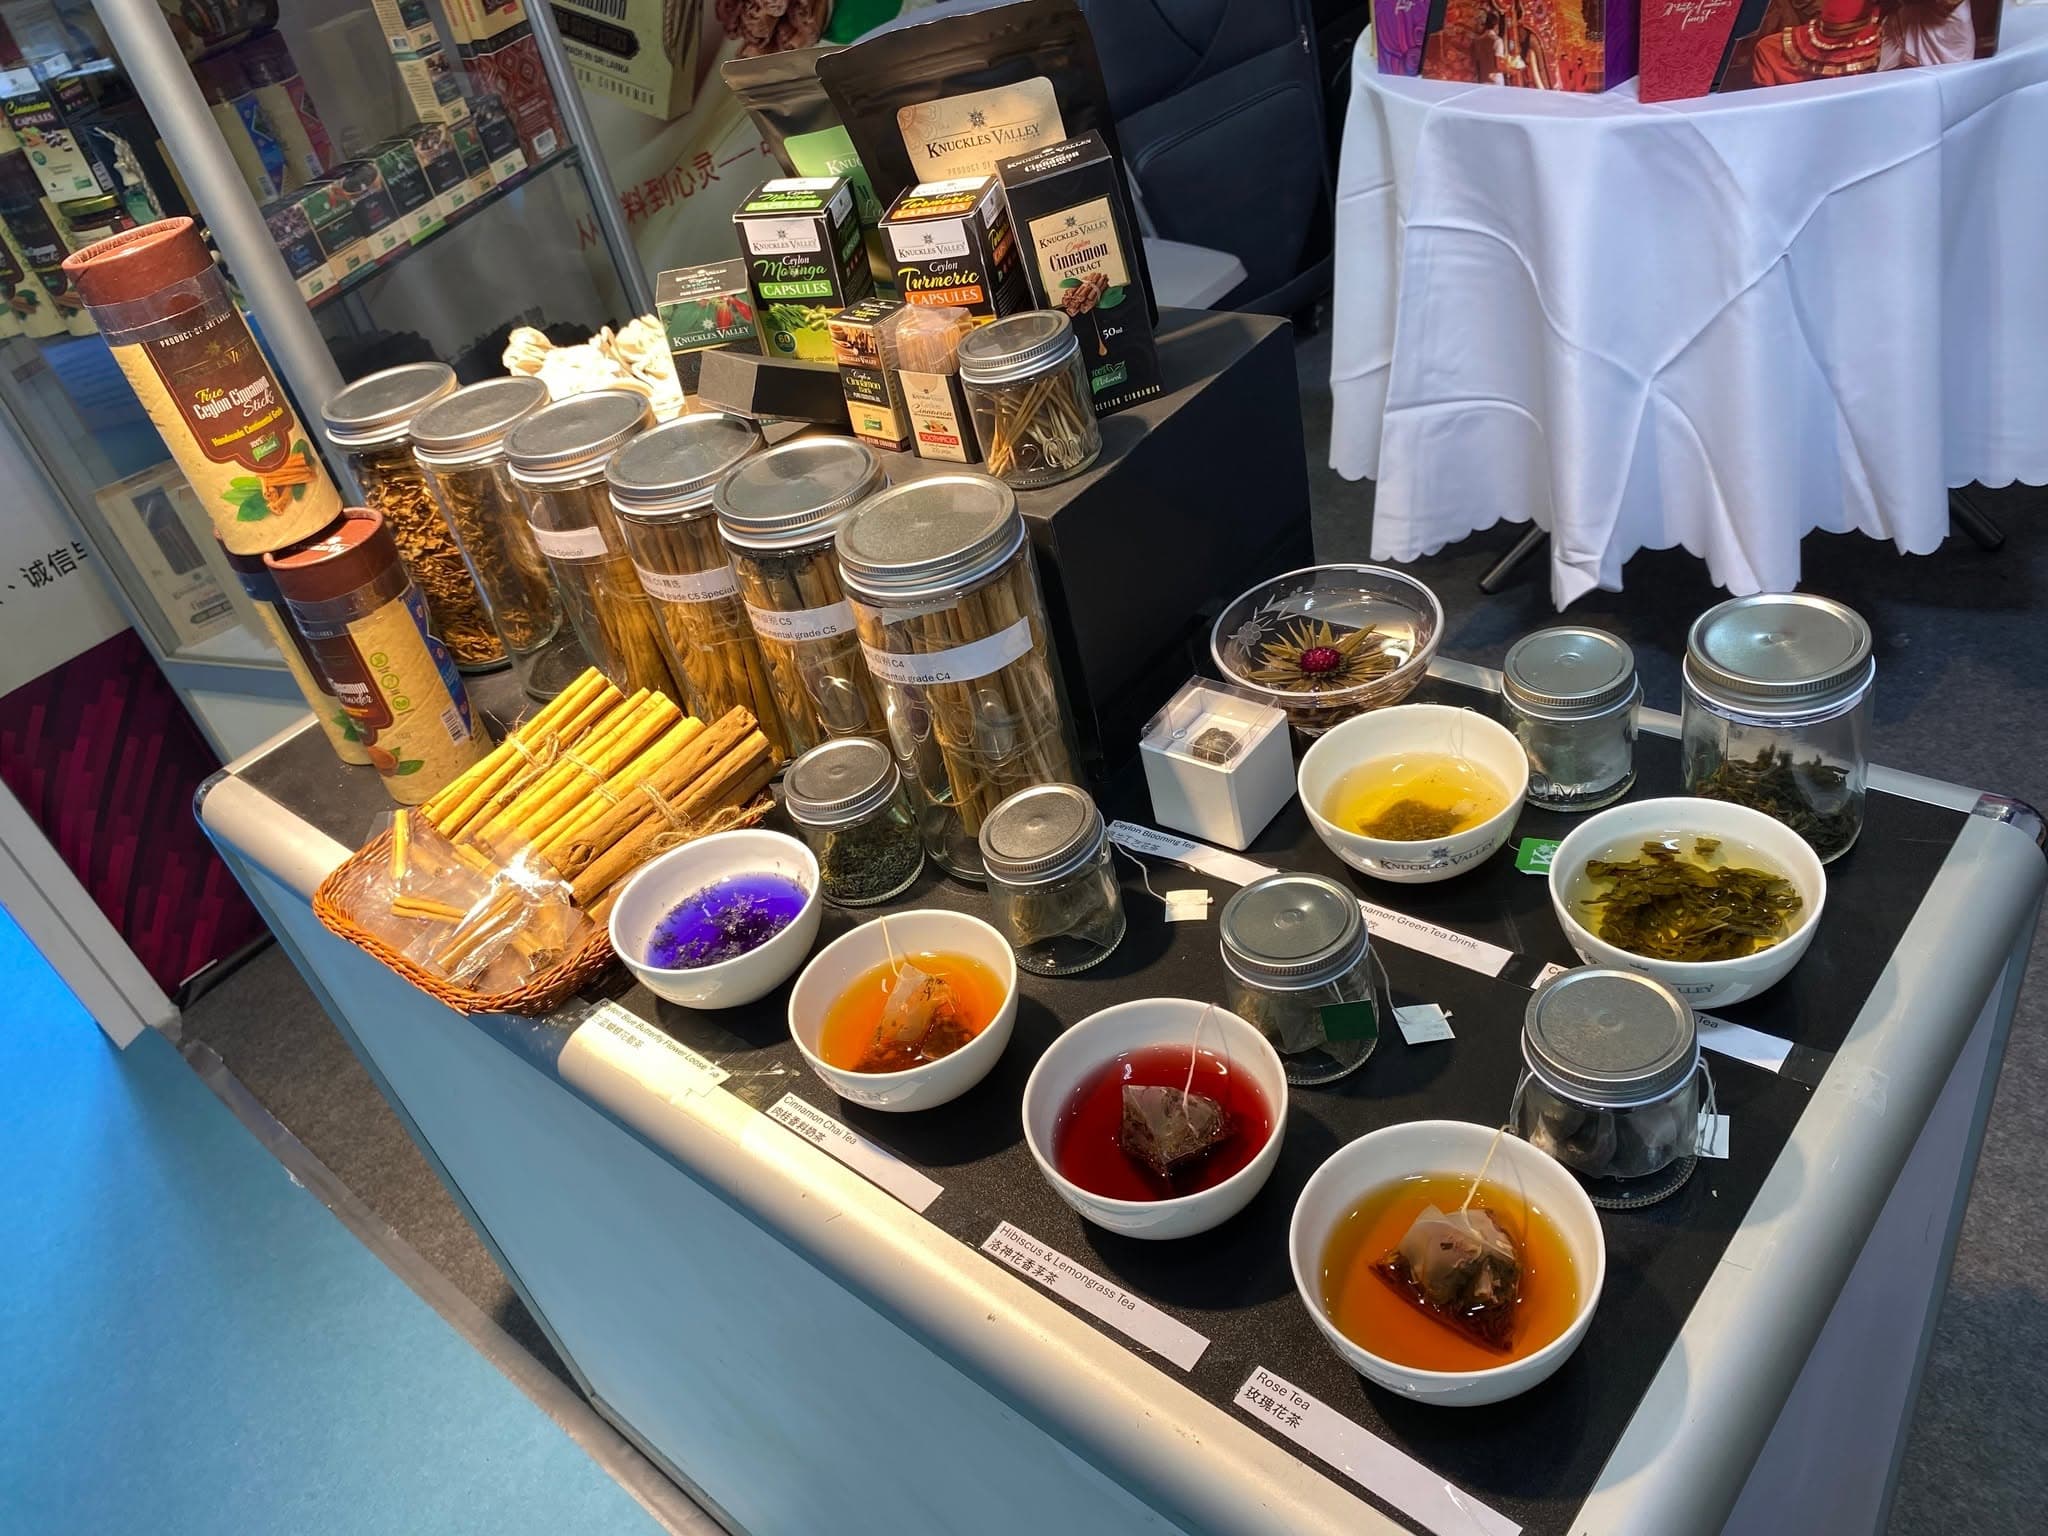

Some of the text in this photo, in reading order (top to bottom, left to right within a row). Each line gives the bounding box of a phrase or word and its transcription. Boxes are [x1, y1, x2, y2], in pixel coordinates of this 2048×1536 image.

[926, 135, 992, 159] KNUCKLES
[991, 123, 1040, 145] VALLEY
[1039, 220, 1109, 250] KNUCKLES VALLEY
[753, 239, 818, 252] KNUCKLES VALLEY
[898, 242, 966, 259] KNUCKLES VALLEY
[782, 255, 810, 266] Ceylon
[929, 260, 958, 274] Ceylon
[1049, 243, 1109, 273] Cinnamon
[753, 259, 827, 282] Moringa
[1064, 260, 1103, 278] EXTRACT
[898, 267, 980, 292] Turmeric
[763, 283, 829, 297] CAPSULES
[911, 289, 979, 306] CAPSULES
[673, 325, 750, 347] KNUCKLES VALLEY
[846, 376, 881, 391] Cinnamon
[193, 375, 270, 420] Ceylon Cinnamon
[688, 592, 700, 600] C5
[701, 584, 736, 599] Special
[779, 617, 792, 626] C5
[794, 630, 821, 640] grade
[822, 625, 837, 635] C5
[891, 659, 905, 669] C4
[907, 674, 935, 684] grade
[936, 672, 951, 681] C4
[1113, 821, 1197, 850] Ceylon Blooming Tea
[1379, 843, 1494, 872] KNUCKLES VALLEY
[1396, 917, 1428, 933] Green
[1429, 927, 1447, 940] Tea
[1449, 934, 1479, 950] Drink
[1677, 983, 1713, 994] LLEY
[1697, 1015, 1719, 1029] Tea
[685, 1053, 708, 1071] Loose
[771, 1106, 827, 1144] 肉桂香料奶茶
[783, 1095, 857, 1145] Cinnamon Chai Tea
[987, 1237, 1060, 1287] 洛神花香茅茶
[999, 1225, 1136, 1311] Hibiscus & Lemongrass Tea
[1256, 1371, 1311, 1411] Rose Tea
[1243, 1385, 1304, 1429] 玫瑰花茶
